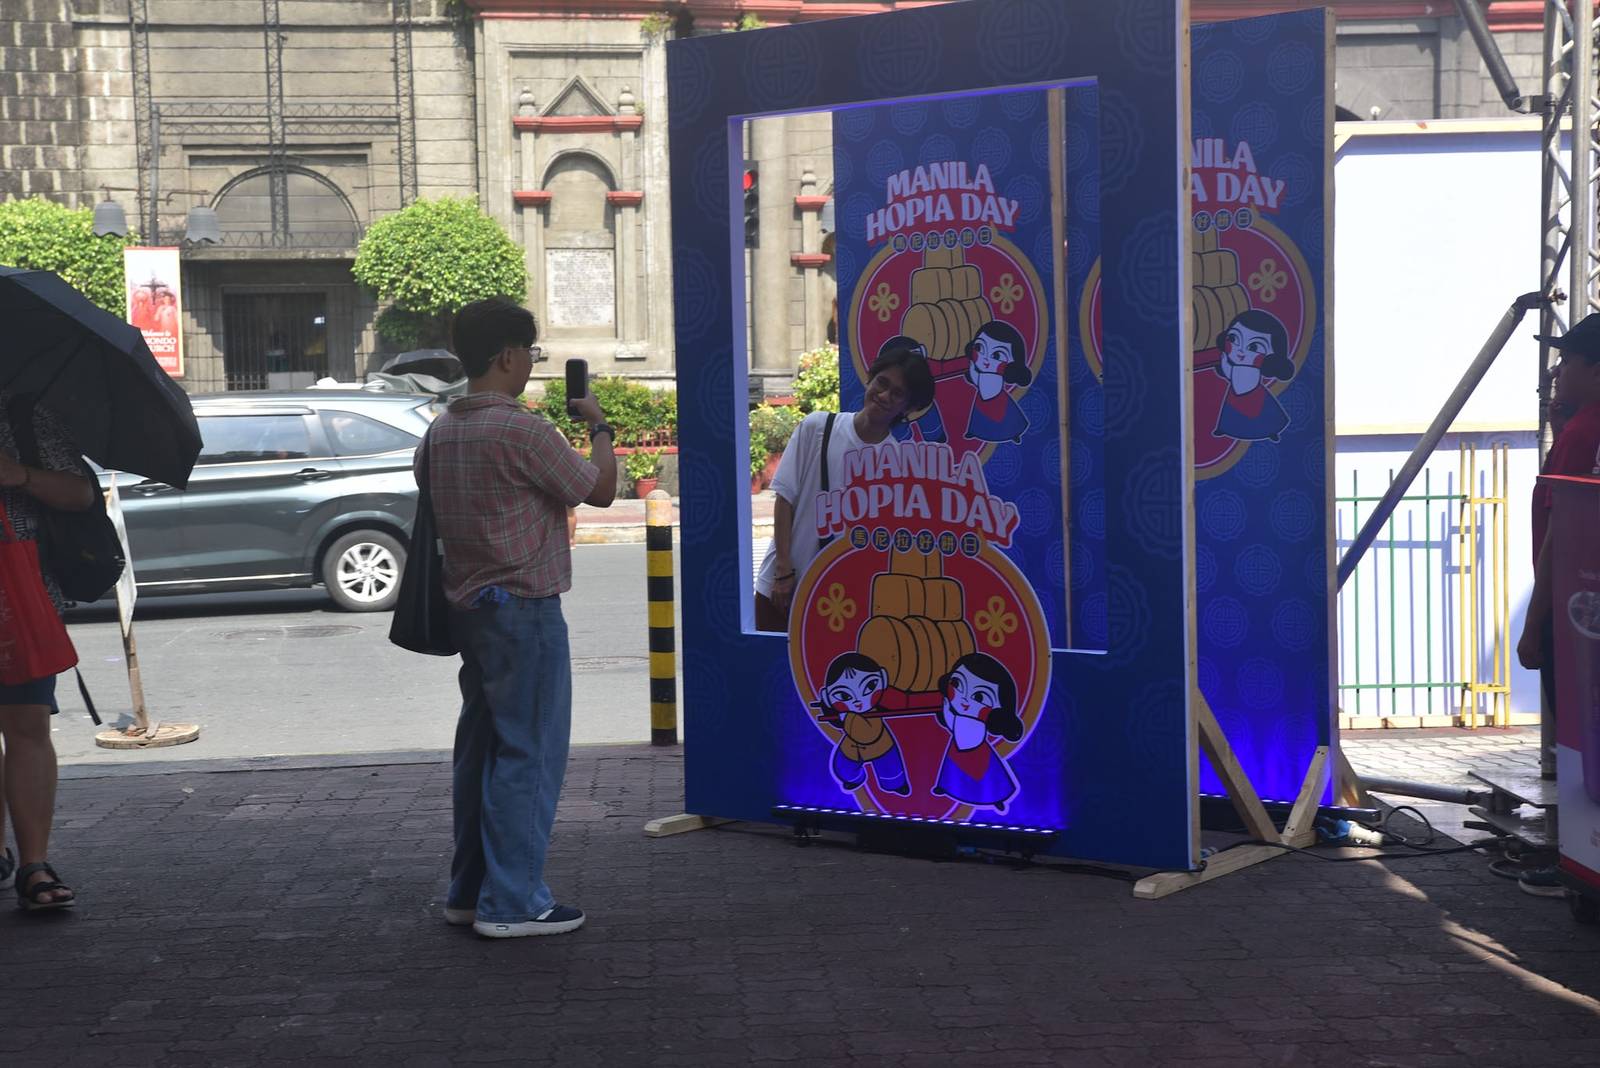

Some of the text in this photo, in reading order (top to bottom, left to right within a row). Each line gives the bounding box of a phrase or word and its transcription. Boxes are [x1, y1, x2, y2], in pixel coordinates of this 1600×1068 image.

[1192, 138, 1257, 174] NILA
[886, 161, 996, 204] MANILA
[1216, 171, 1286, 209] DAY
[866, 192, 1019, 242] HOPIA DAY
[844, 442, 986, 494] MANILA
[815, 483, 1016, 540] HOPIA DAY
